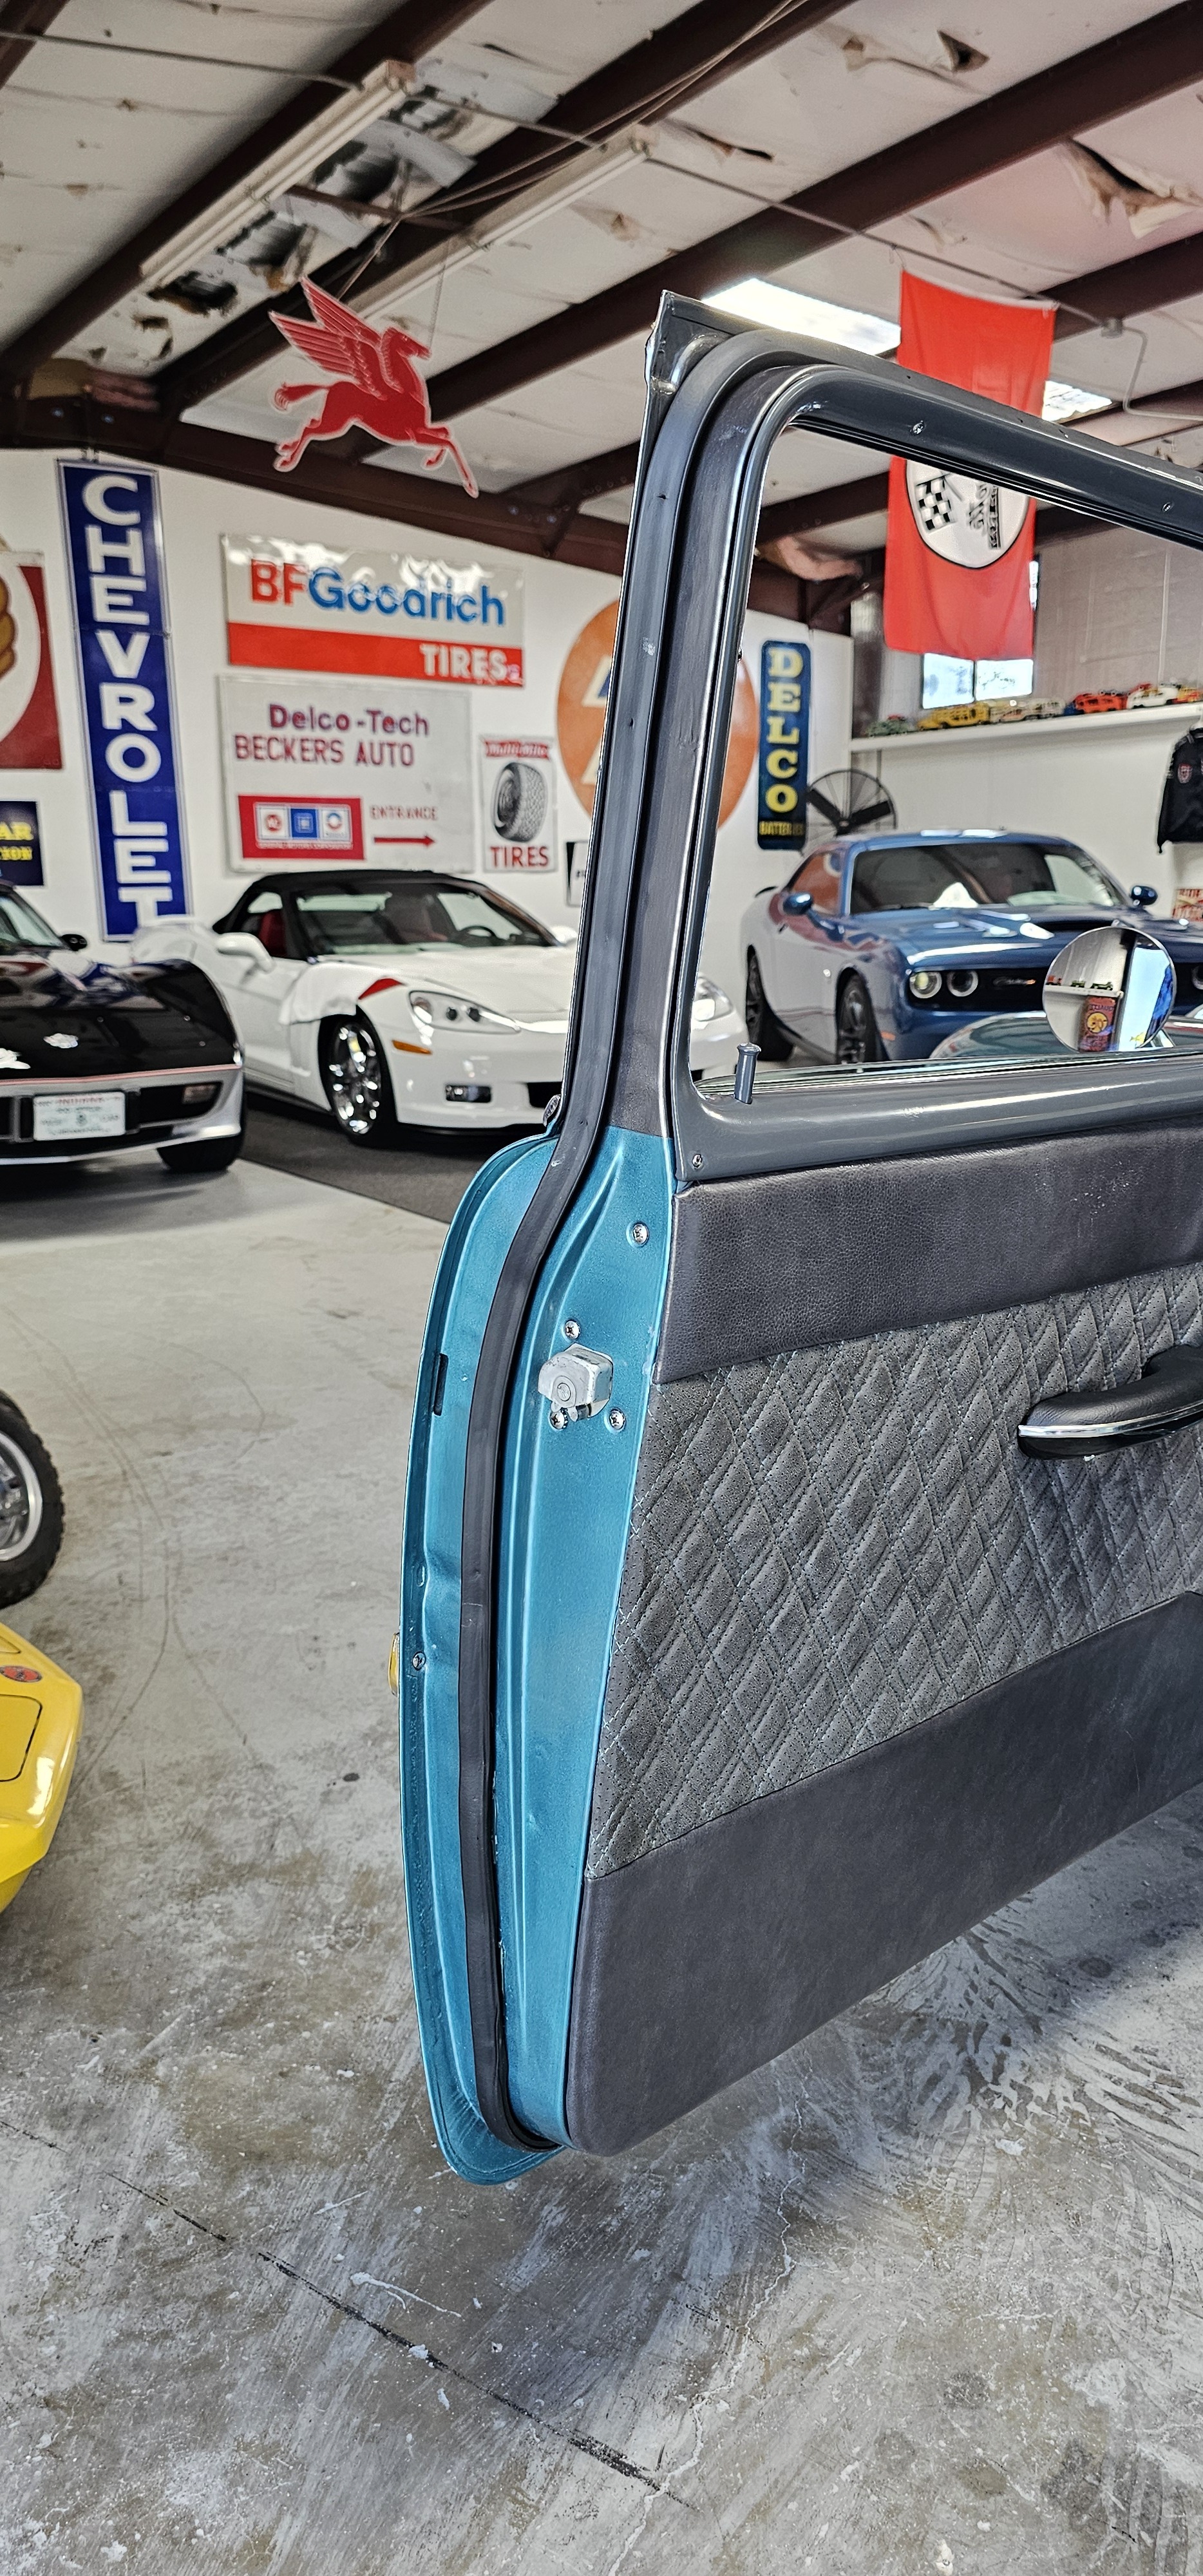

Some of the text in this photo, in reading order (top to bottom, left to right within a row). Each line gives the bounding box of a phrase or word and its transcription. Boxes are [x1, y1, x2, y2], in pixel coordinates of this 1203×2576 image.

[251, 558, 504, 626] BFGoodrich
[419, 643, 507, 681] TIRES
[82, 474, 173, 925] CHEVROLET
[765, 646, 804, 814] DELCO
[234, 734, 415, 767] BECKERS AUTO
[370, 804, 438, 821] ENTRANCE
[490, 846, 549, 867] TIRES
